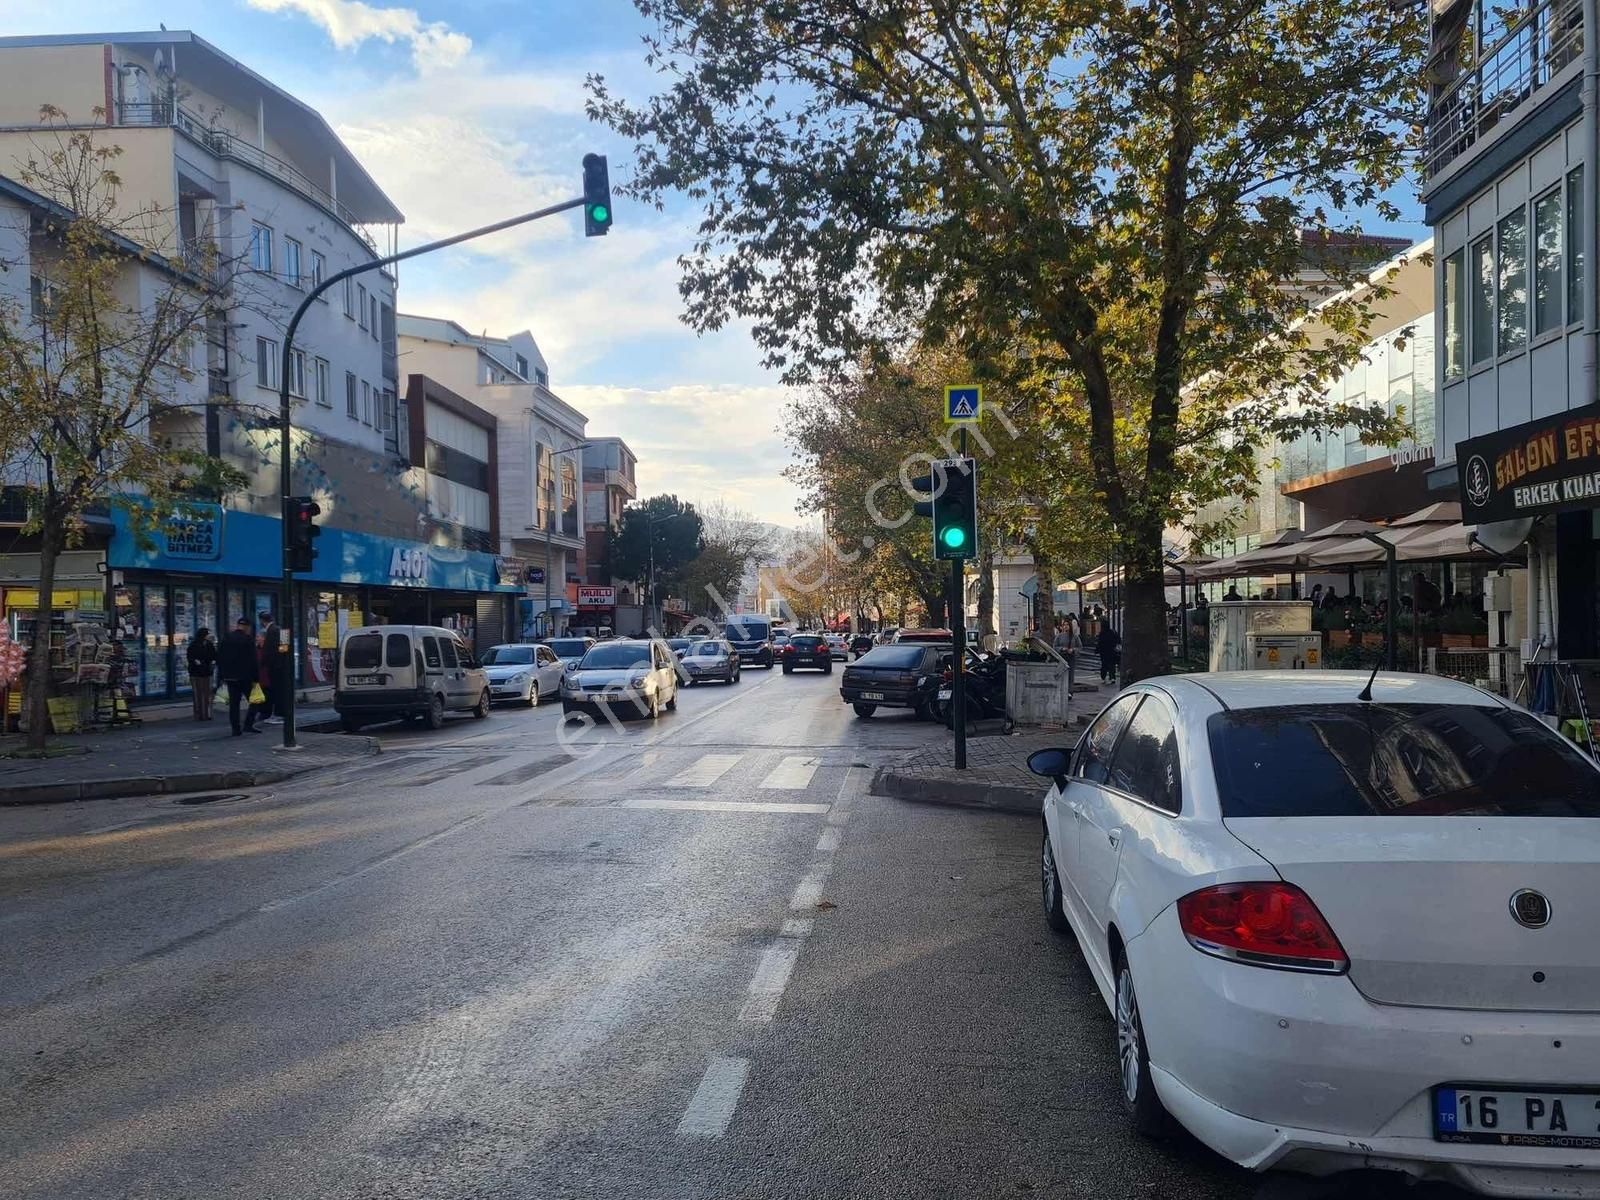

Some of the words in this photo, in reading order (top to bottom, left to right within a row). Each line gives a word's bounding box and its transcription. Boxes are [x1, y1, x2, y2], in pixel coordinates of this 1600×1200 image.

[1494, 434, 1557, 490] SALON
[1514, 481, 1559, 508] ERKEK
[1440, 1112, 1455, 1123] TR
[1460, 1095, 1498, 1129] 16
[1525, 1098, 1568, 1131] PA
